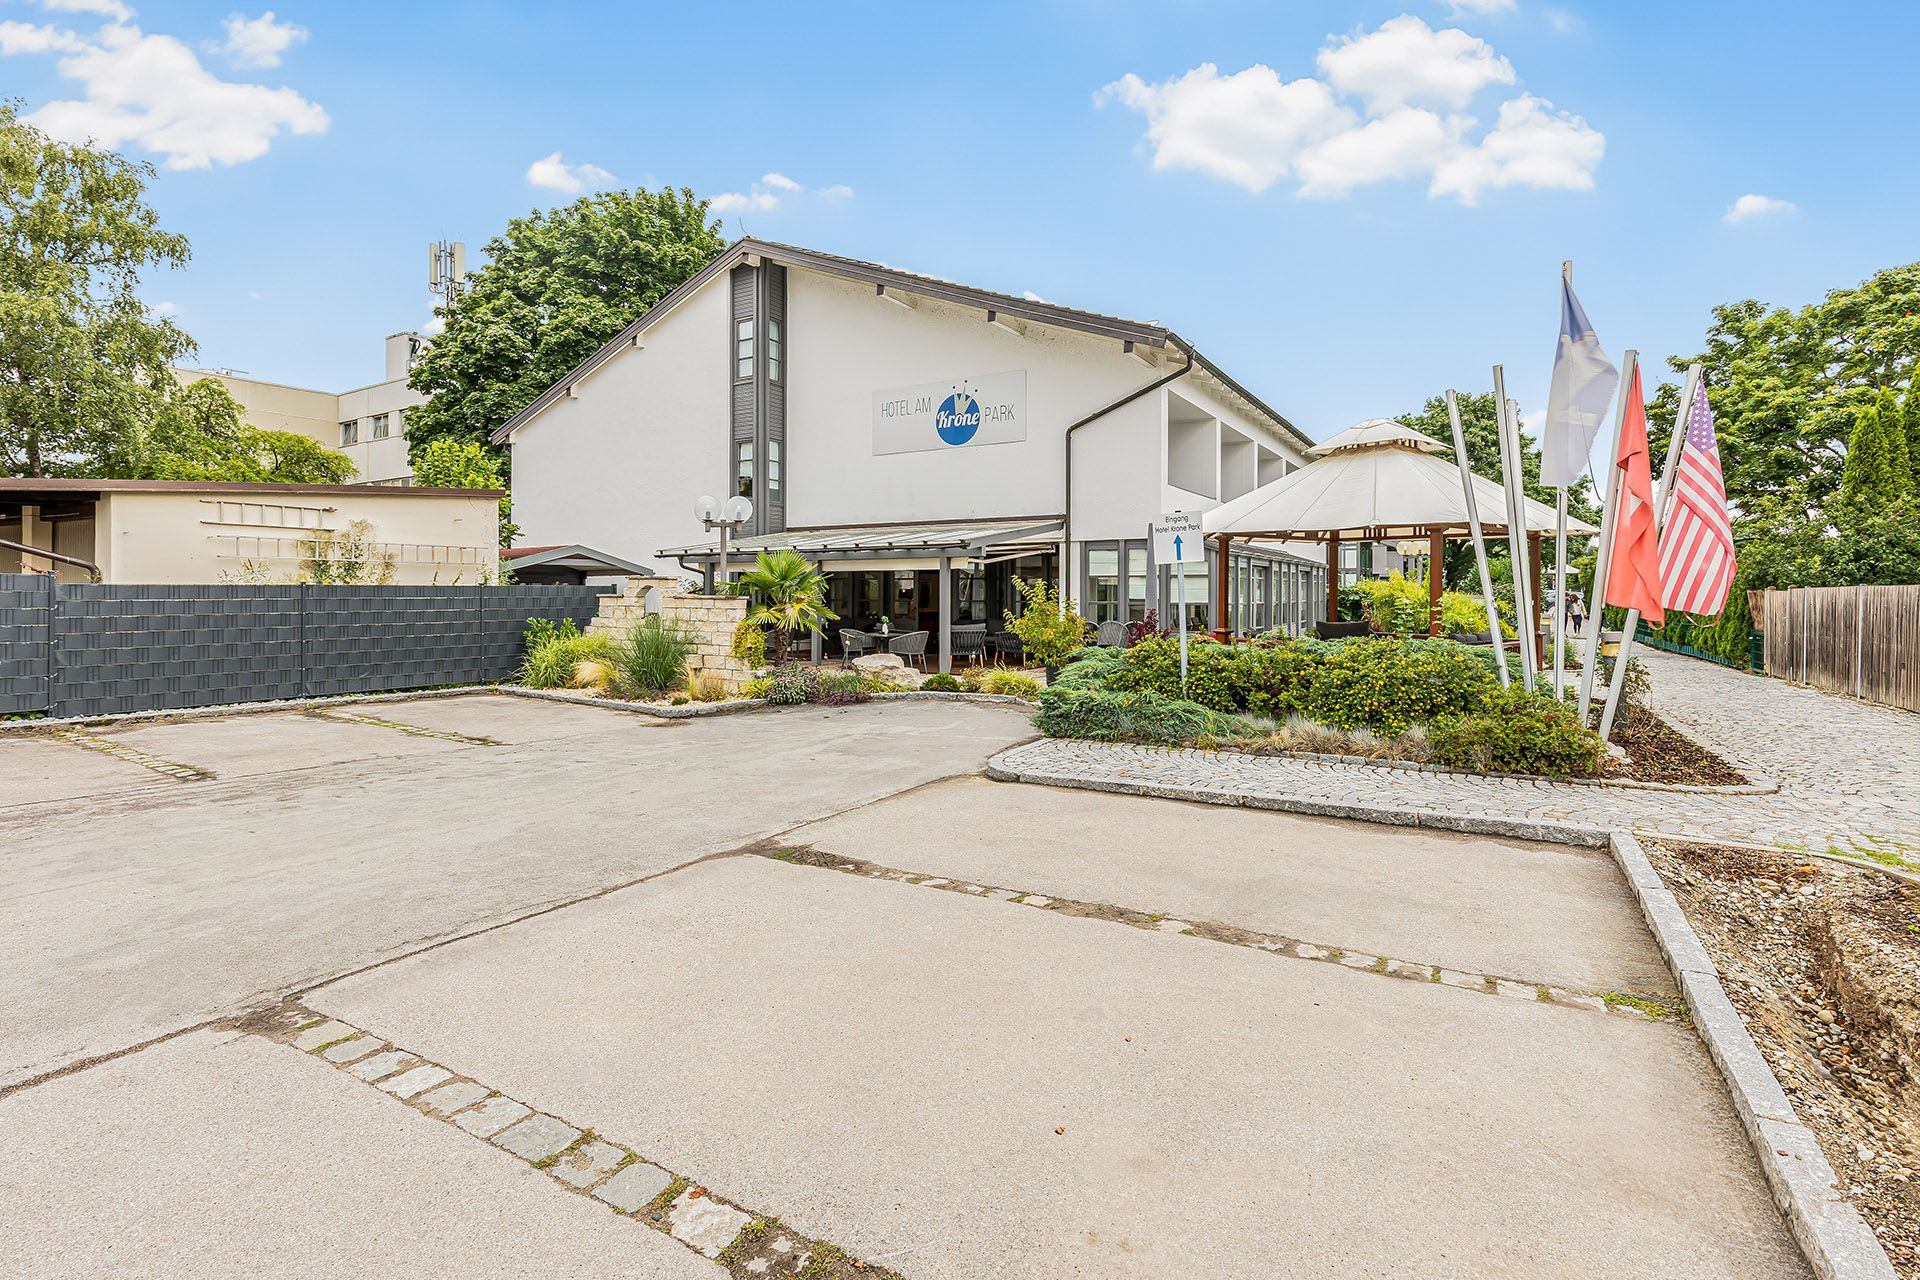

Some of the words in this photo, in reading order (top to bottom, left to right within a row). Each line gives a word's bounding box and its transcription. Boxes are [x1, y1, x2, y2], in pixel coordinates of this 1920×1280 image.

[881, 399, 911, 418] HOTEL
[915, 397, 931, 414] AM
[936, 410, 980, 428] Krone
[984, 404, 1015, 423] PARK
[1165, 515, 1189, 524] Eingang
